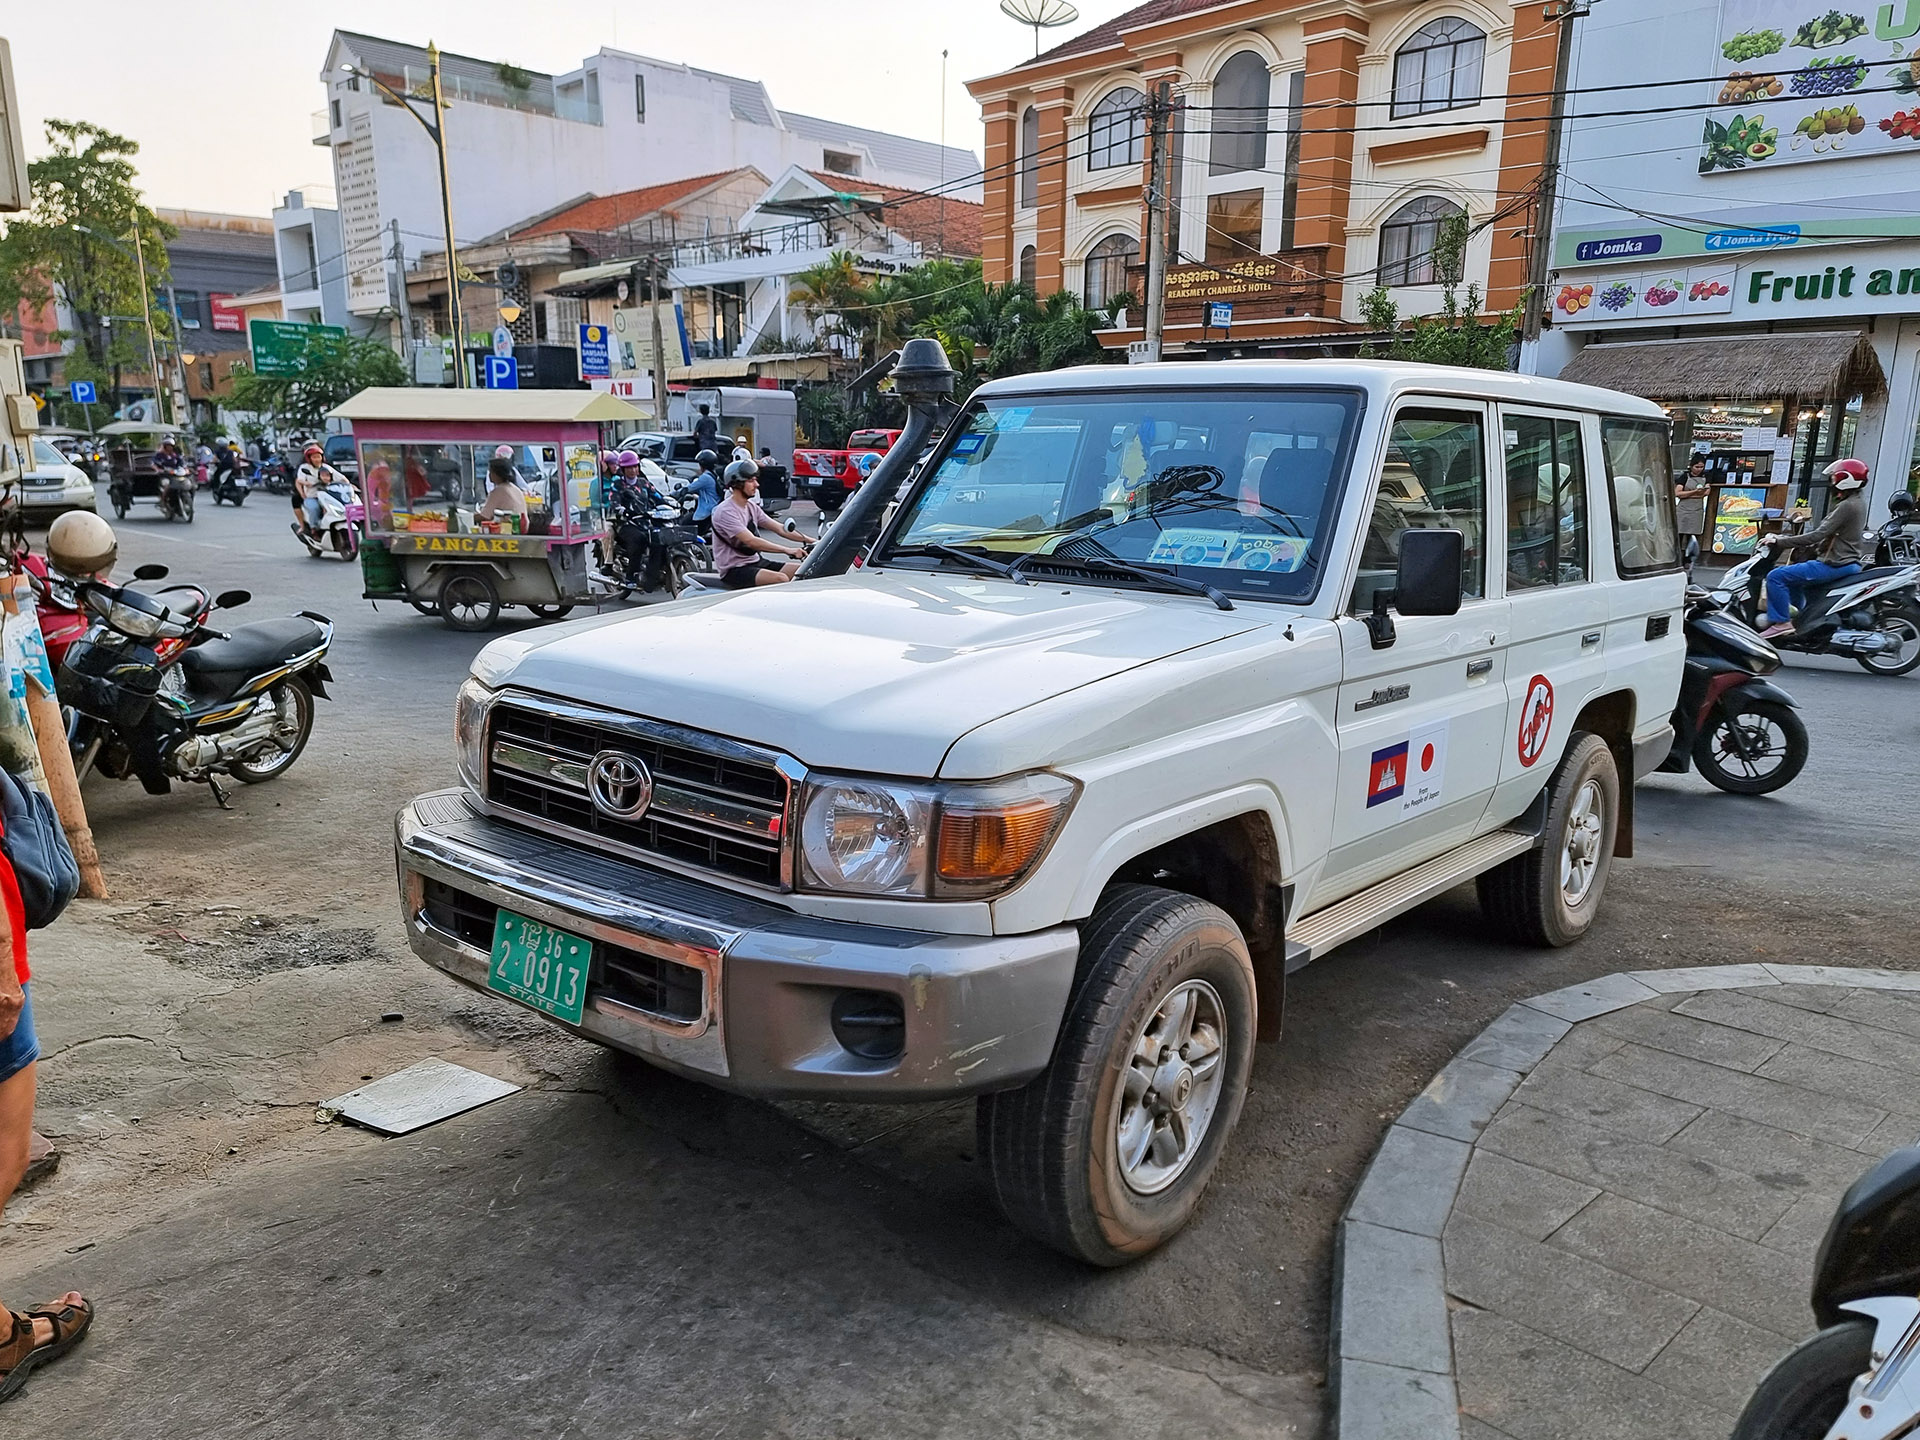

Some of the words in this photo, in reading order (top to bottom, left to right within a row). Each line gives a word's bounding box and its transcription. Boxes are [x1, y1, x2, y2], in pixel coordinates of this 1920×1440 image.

[1594, 240, 1643, 255] Jomka
[1724, 234, 1763, 245] Jomka
[856, 255, 896, 273] OneStop
[1167, 287, 1206, 299] REAKSMEY
[1207, 284, 1247, 296] CHANREAS
[1248, 282, 1272, 292] HOTEL
[1748, 265, 1856, 304] Fruit
[1213, 310, 1229, 318] ATM
[492, 359, 511, 388] P
[76, 382, 90, 403] P
[610, 382, 633, 396] ATM
[414, 536, 520, 553] PANCAKE
[1411, 796, 1423, 807] People
[1429, 791, 1440, 800] Japan
[545, 928, 564, 958] 36
[509, 985, 556, 1011] STATE
